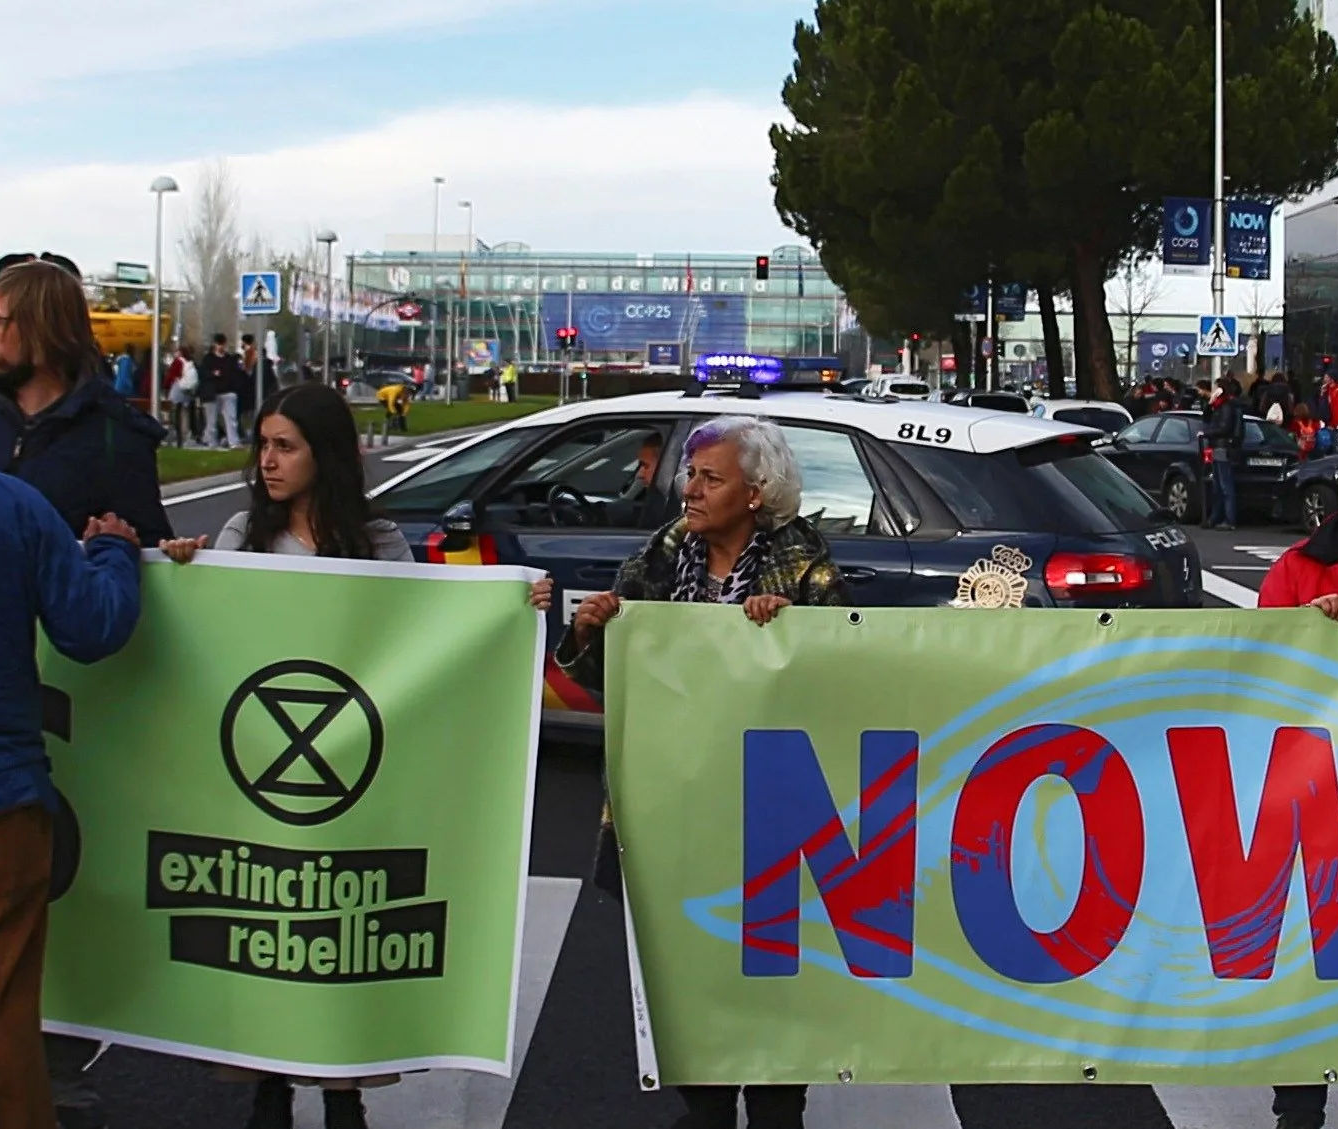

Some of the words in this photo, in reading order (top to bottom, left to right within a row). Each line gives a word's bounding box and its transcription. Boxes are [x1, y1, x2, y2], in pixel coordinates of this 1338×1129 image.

[1230, 212, 1265, 229] NOW
[1172, 238, 1199, 248] COP25
[505, 274, 587, 290] Feria
[611, 275, 641, 291] de
[663, 276, 765, 292] Mdrid
[897, 423, 953, 444] 8L9
[160, 846, 388, 911] extinction
[228, 906, 435, 975] rebellion
